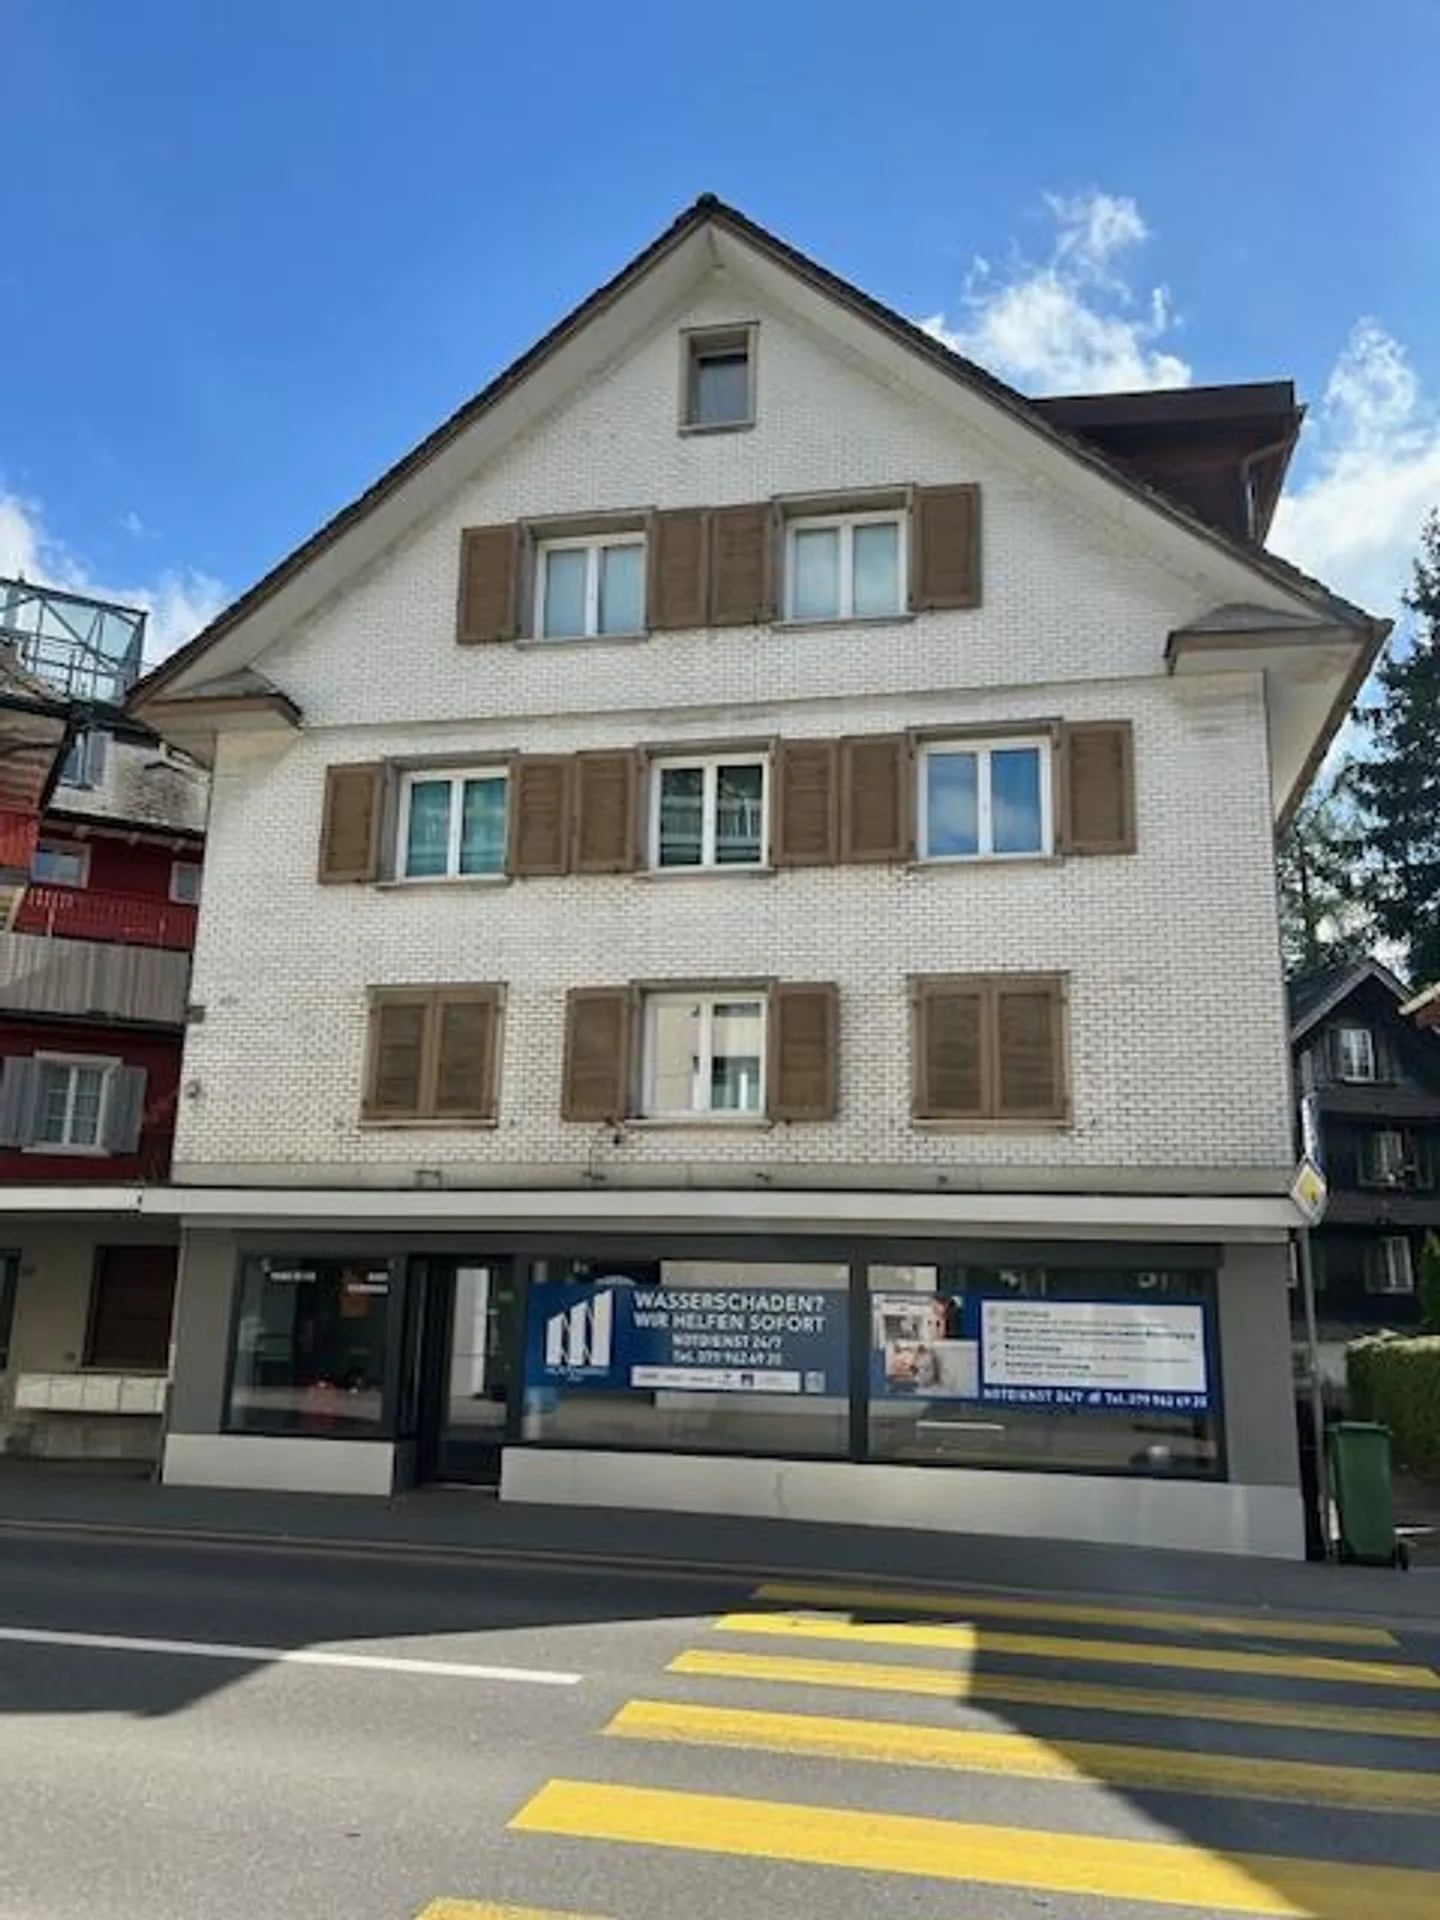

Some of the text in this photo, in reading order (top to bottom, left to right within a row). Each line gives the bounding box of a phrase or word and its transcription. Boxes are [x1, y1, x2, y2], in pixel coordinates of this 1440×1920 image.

[634, 1292, 825, 1312] WASSERSCHADEN?
[634, 1312, 825, 1332] WIR HELFEN SOFORT
